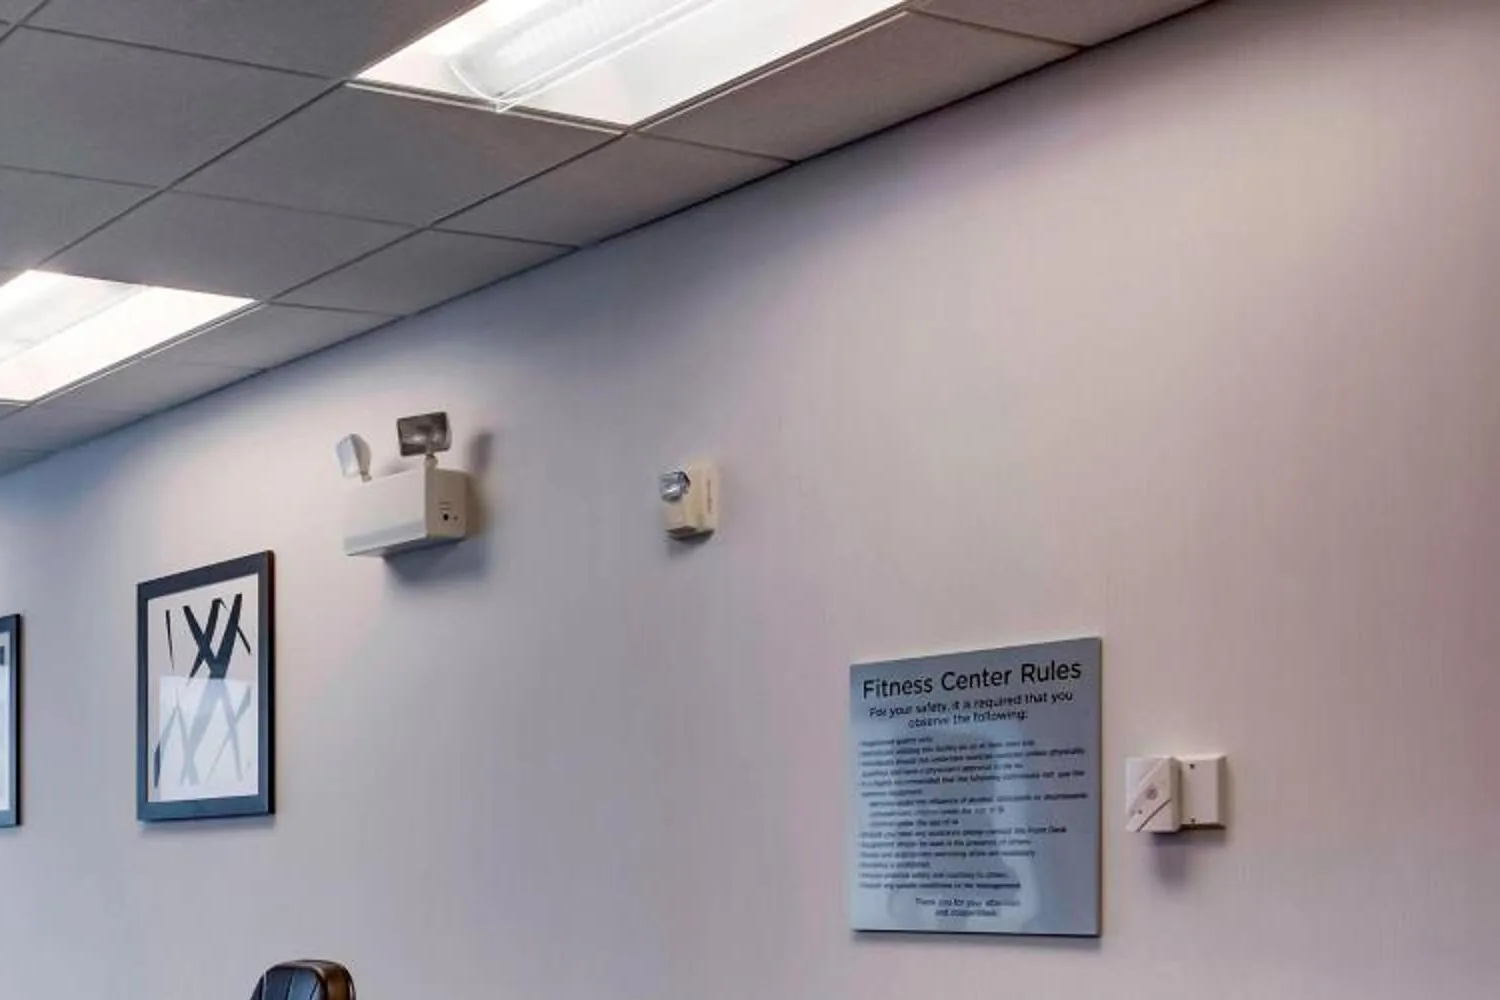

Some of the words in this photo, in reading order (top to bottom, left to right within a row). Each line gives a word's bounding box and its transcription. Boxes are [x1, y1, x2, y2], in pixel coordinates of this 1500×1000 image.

[863, 677, 933, 699] Fitness
[941, 667, 1012, 691] Center
[1021, 660, 1082, 684] Rules
[869, 706, 886, 717] For
[889, 705, 912, 719] your
[1025, 691, 1047, 704] that
[1051, 691, 1073, 704] you
[953, 713, 970, 725] the
